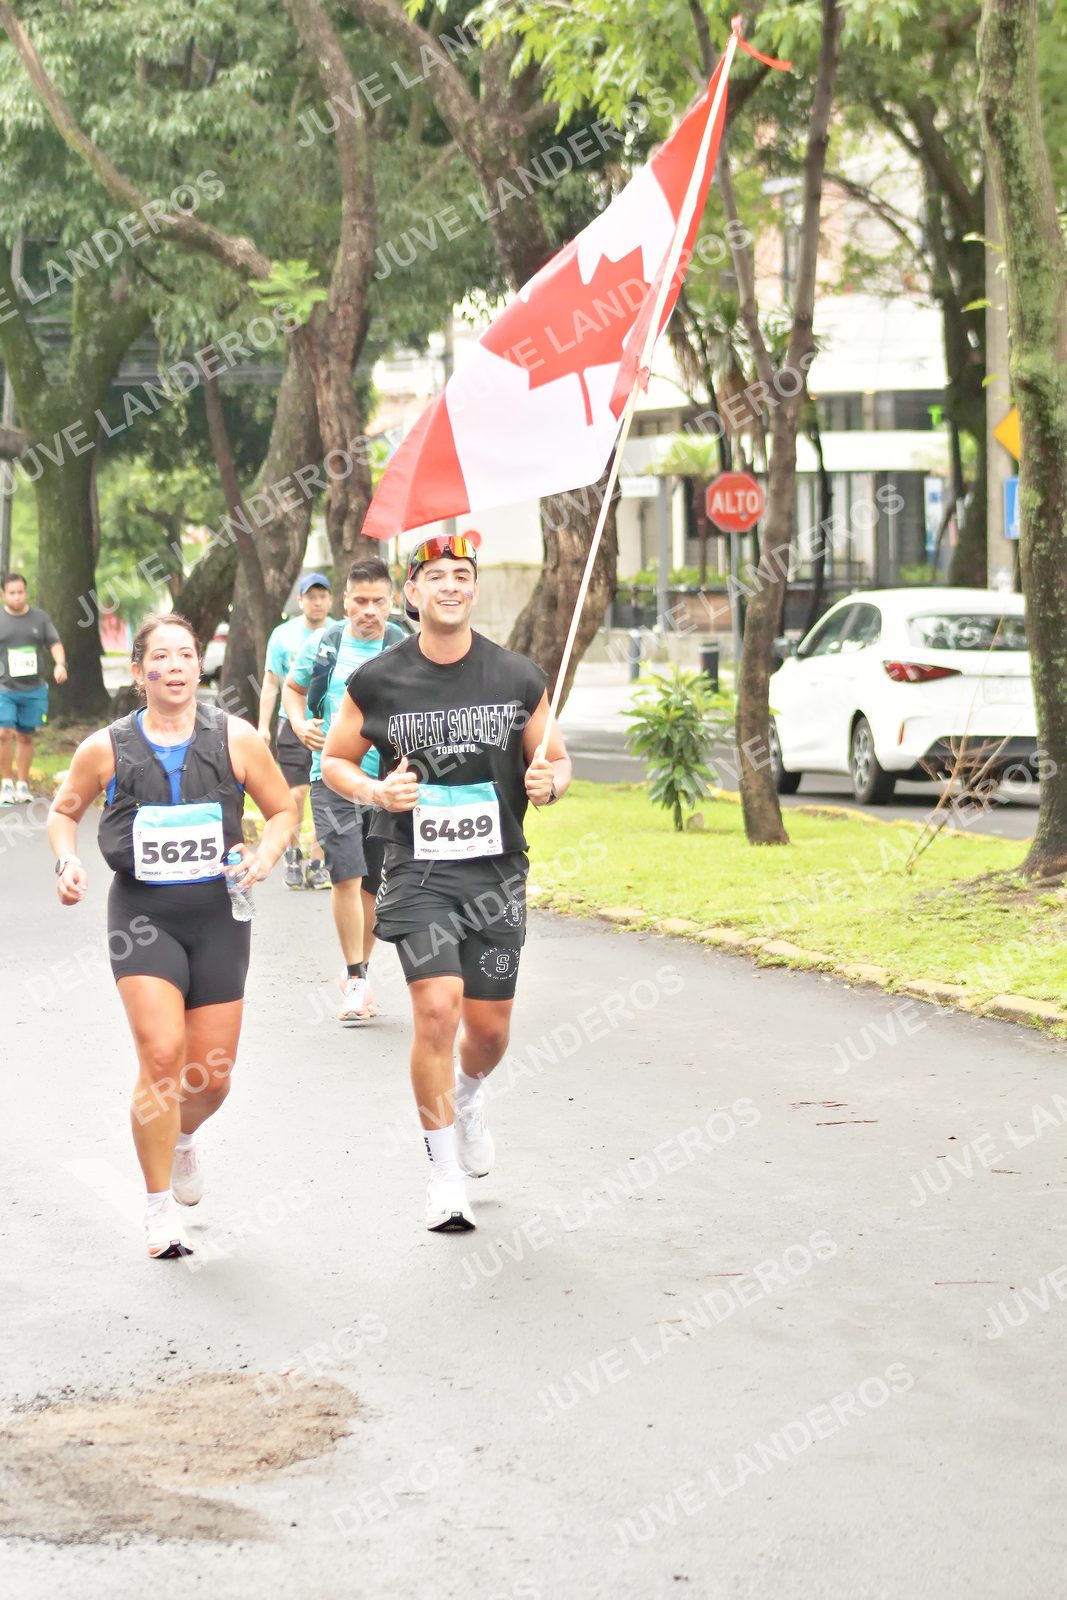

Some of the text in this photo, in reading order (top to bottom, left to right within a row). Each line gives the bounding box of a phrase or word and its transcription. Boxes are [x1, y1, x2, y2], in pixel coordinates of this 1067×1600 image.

[711, 490, 759, 514] ALTO
[387, 704, 516, 759] SWEAT SOCIETY
[436, 744, 476, 755] TORONTO
[420, 815, 493, 841] 6489
[141, 837, 217, 864] 5625
[496, 954, 509, 973] S
